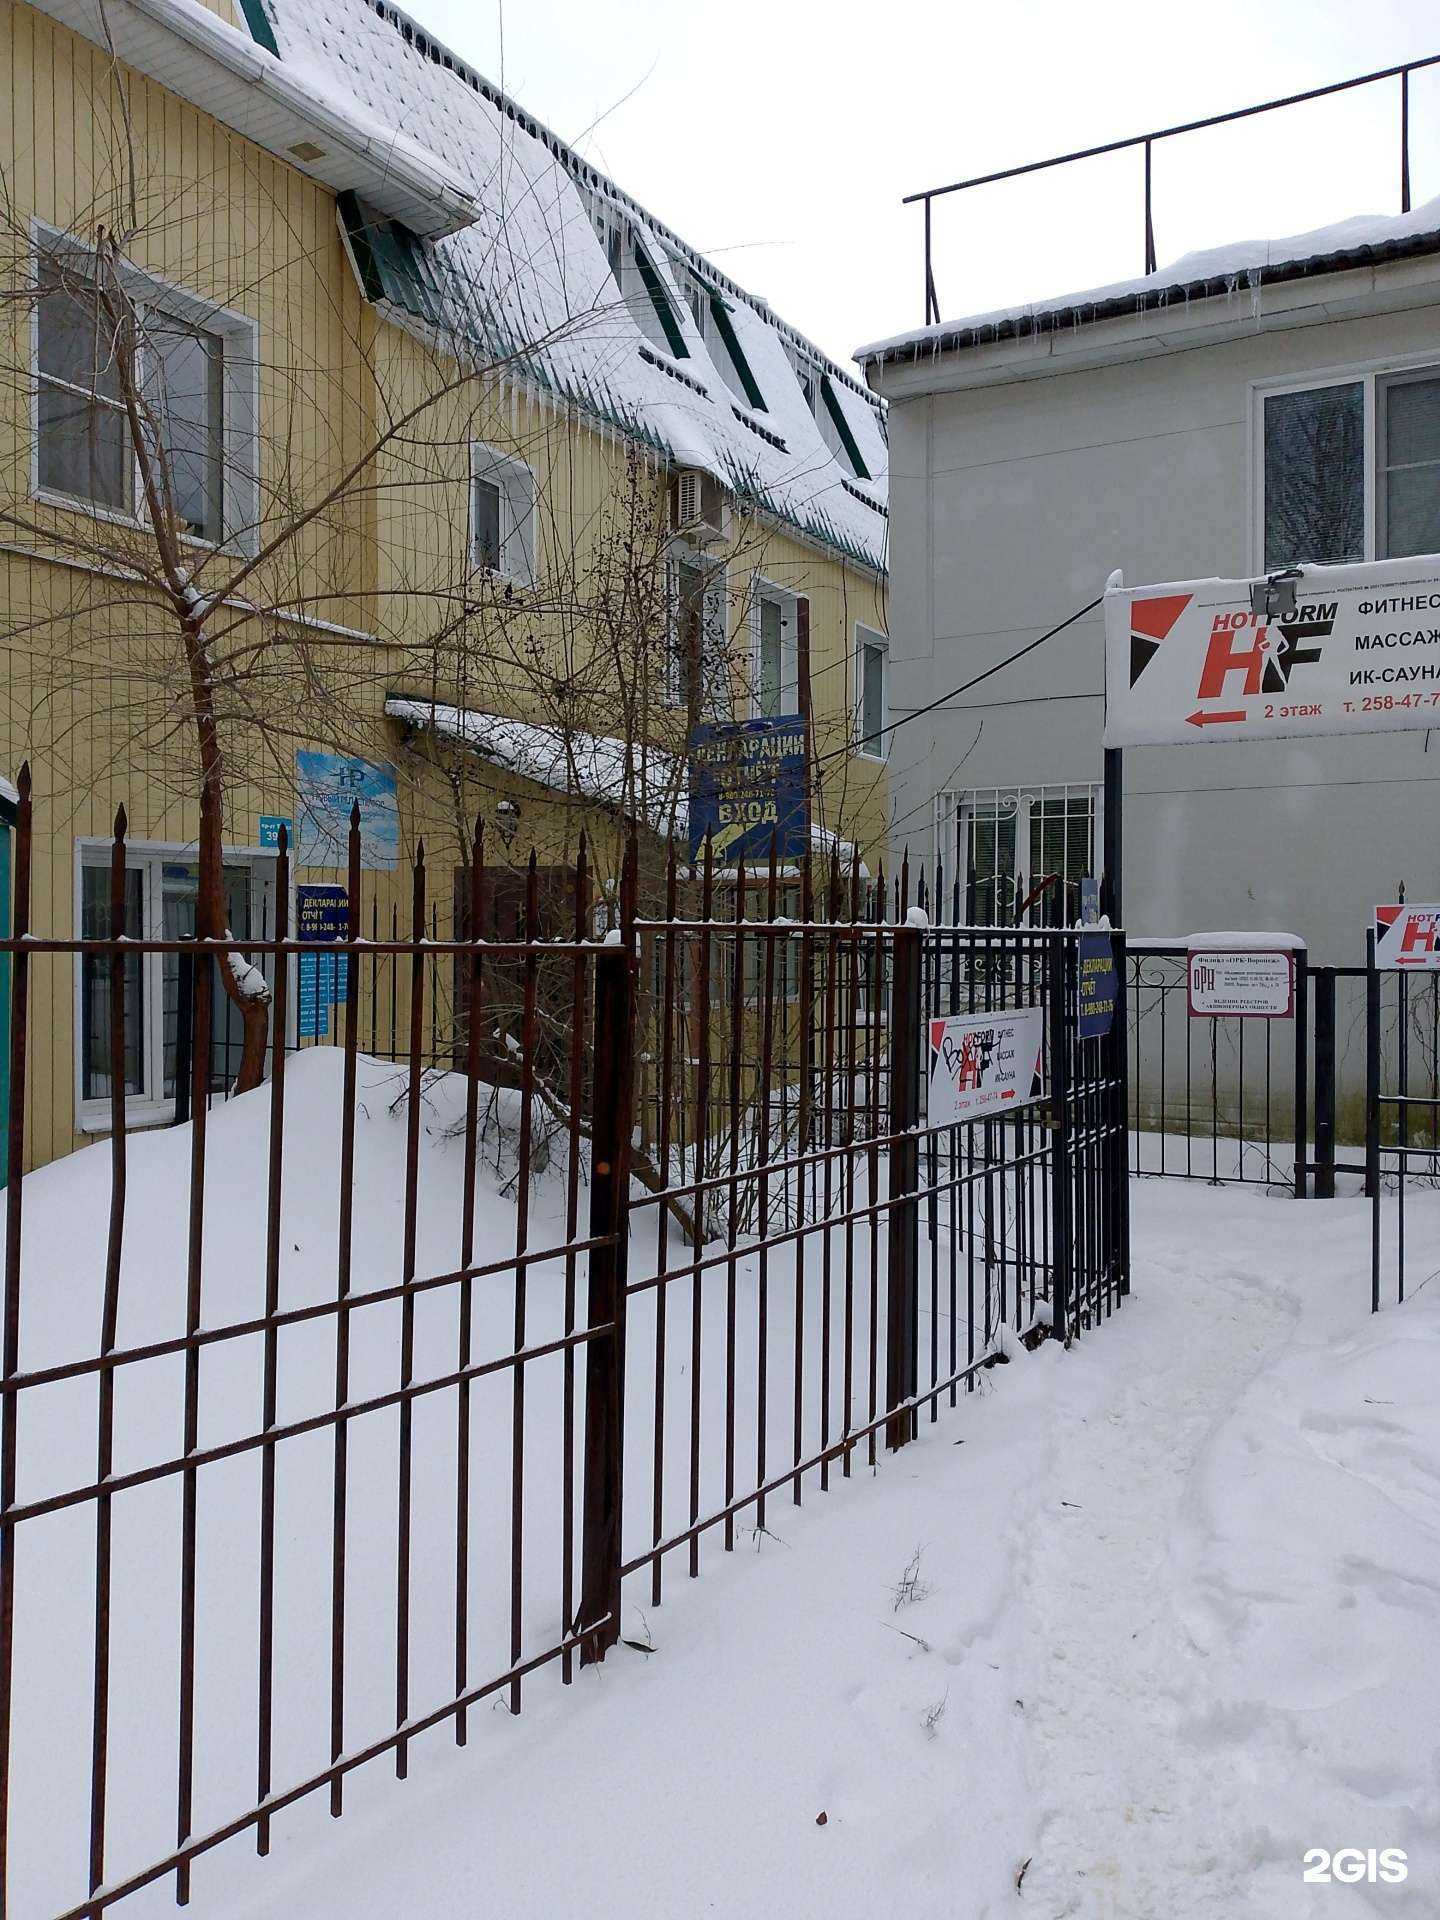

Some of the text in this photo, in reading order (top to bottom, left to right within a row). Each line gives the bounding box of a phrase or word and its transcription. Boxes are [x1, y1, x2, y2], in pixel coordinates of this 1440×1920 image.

[1358, 594, 1440, 615] ФИТНЕС
[1211, 611, 1260, 631] HOT
[1349, 664, 1440, 685] ИК-САУН
[1264, 704, 1322, 718] 2 этаж
[1343, 702, 1355, 713] т.
[718, 800, 778, 824] ВХОД
[303, 898, 349, 909] ДЕКЛАРАИИ
[1408, 913, 1434, 922] HOT
